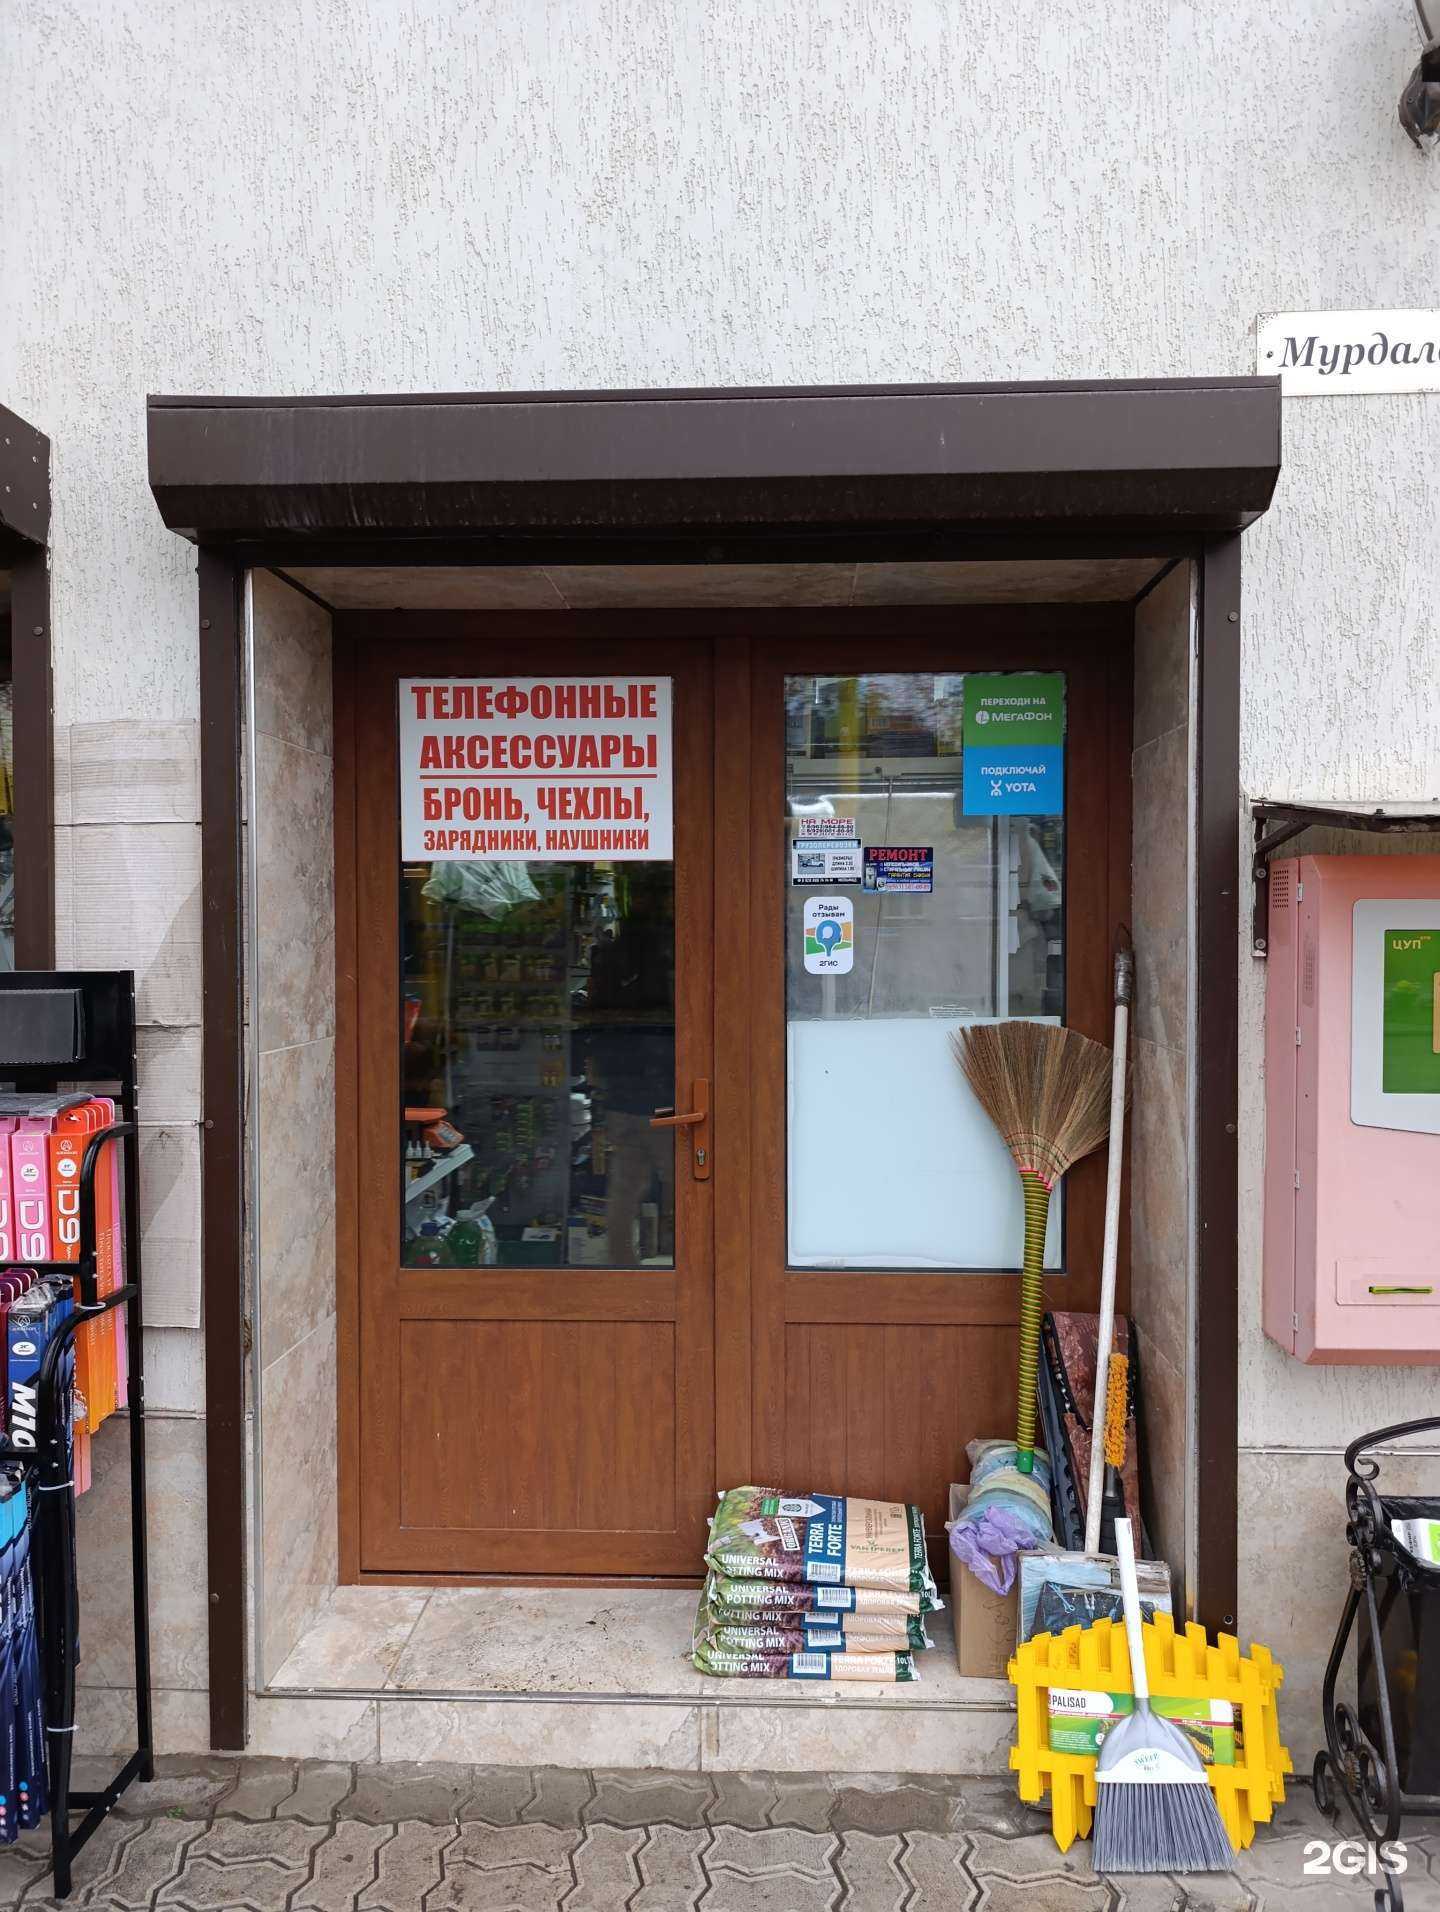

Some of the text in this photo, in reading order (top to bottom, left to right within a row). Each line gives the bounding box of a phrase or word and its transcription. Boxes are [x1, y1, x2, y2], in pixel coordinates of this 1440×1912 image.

[1278, 332, 1440, 375] Мурдал
[411, 685, 657, 719] ТЕЛЕФОННЫЕ
[981, 697, 1046, 706] ПЕРЕХОДИ НА
[420, 735, 657, 769] АКСЕССУАРЫ
[981, 764, 1046, 776] ПОДКЛЮЧАЙ
[1005, 783, 1037, 792] YOTA
[424, 787, 650, 823] БРОНЬ, ЧЕХЛЫ,
[424, 829, 649, 853] ЗАРЯДНИКИ, НАУШНИКИ
[870, 848, 927, 861] РЕМОНТ
[1392, 940, 1421, 950] ЦУП
[12, 1381, 37, 1448] M10
[808, 1523, 824, 1554] TERRA
[827, 1523, 842, 1556] FORTE
[721, 1554, 780, 1566] UNIVERSAL
[764, 1568, 784, 1578] MIX
[730, 1585, 789, 1593] UNIVERSAL
[727, 1595, 794, 1605] POTTING MIX
[762, 1611, 782, 1621] MIX
[723, 1626, 779, 1635] UNIVERSAL
[720, 1635, 785, 1647] POTTING MIX
[707, 1651, 764, 1660] UNIVERSAL
[750, 1662, 770, 1671] MIX
[1052, 1695, 1086, 1708] PALISAD
